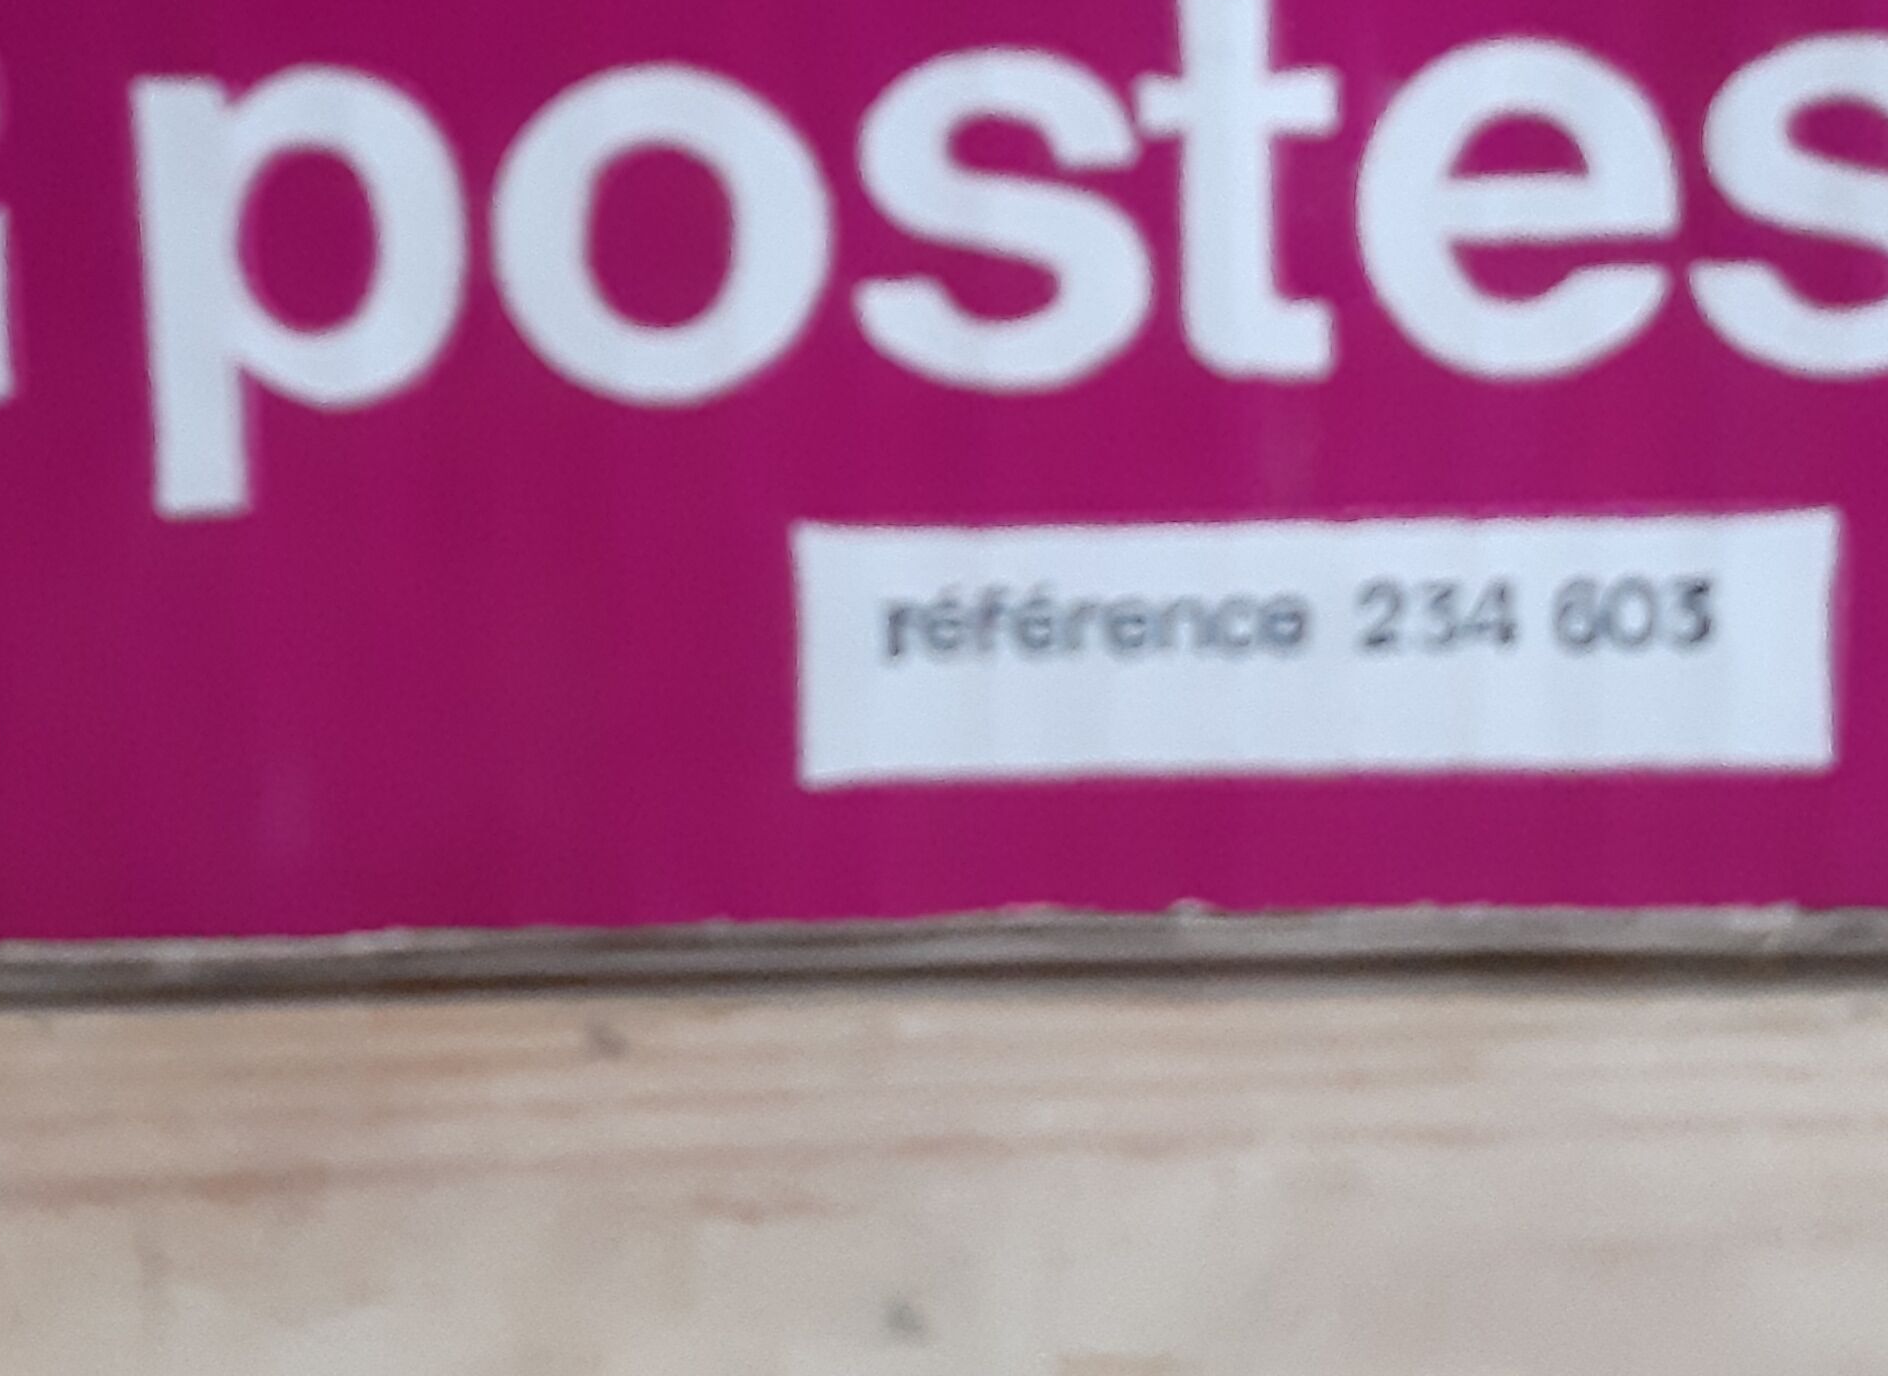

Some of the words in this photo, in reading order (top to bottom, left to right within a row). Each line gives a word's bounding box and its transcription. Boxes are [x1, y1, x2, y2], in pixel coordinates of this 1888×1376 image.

[880, 582, 1311, 661] référence
[1356, 578, 1518, 652] 234
[1554, 576, 1718, 652] 603
